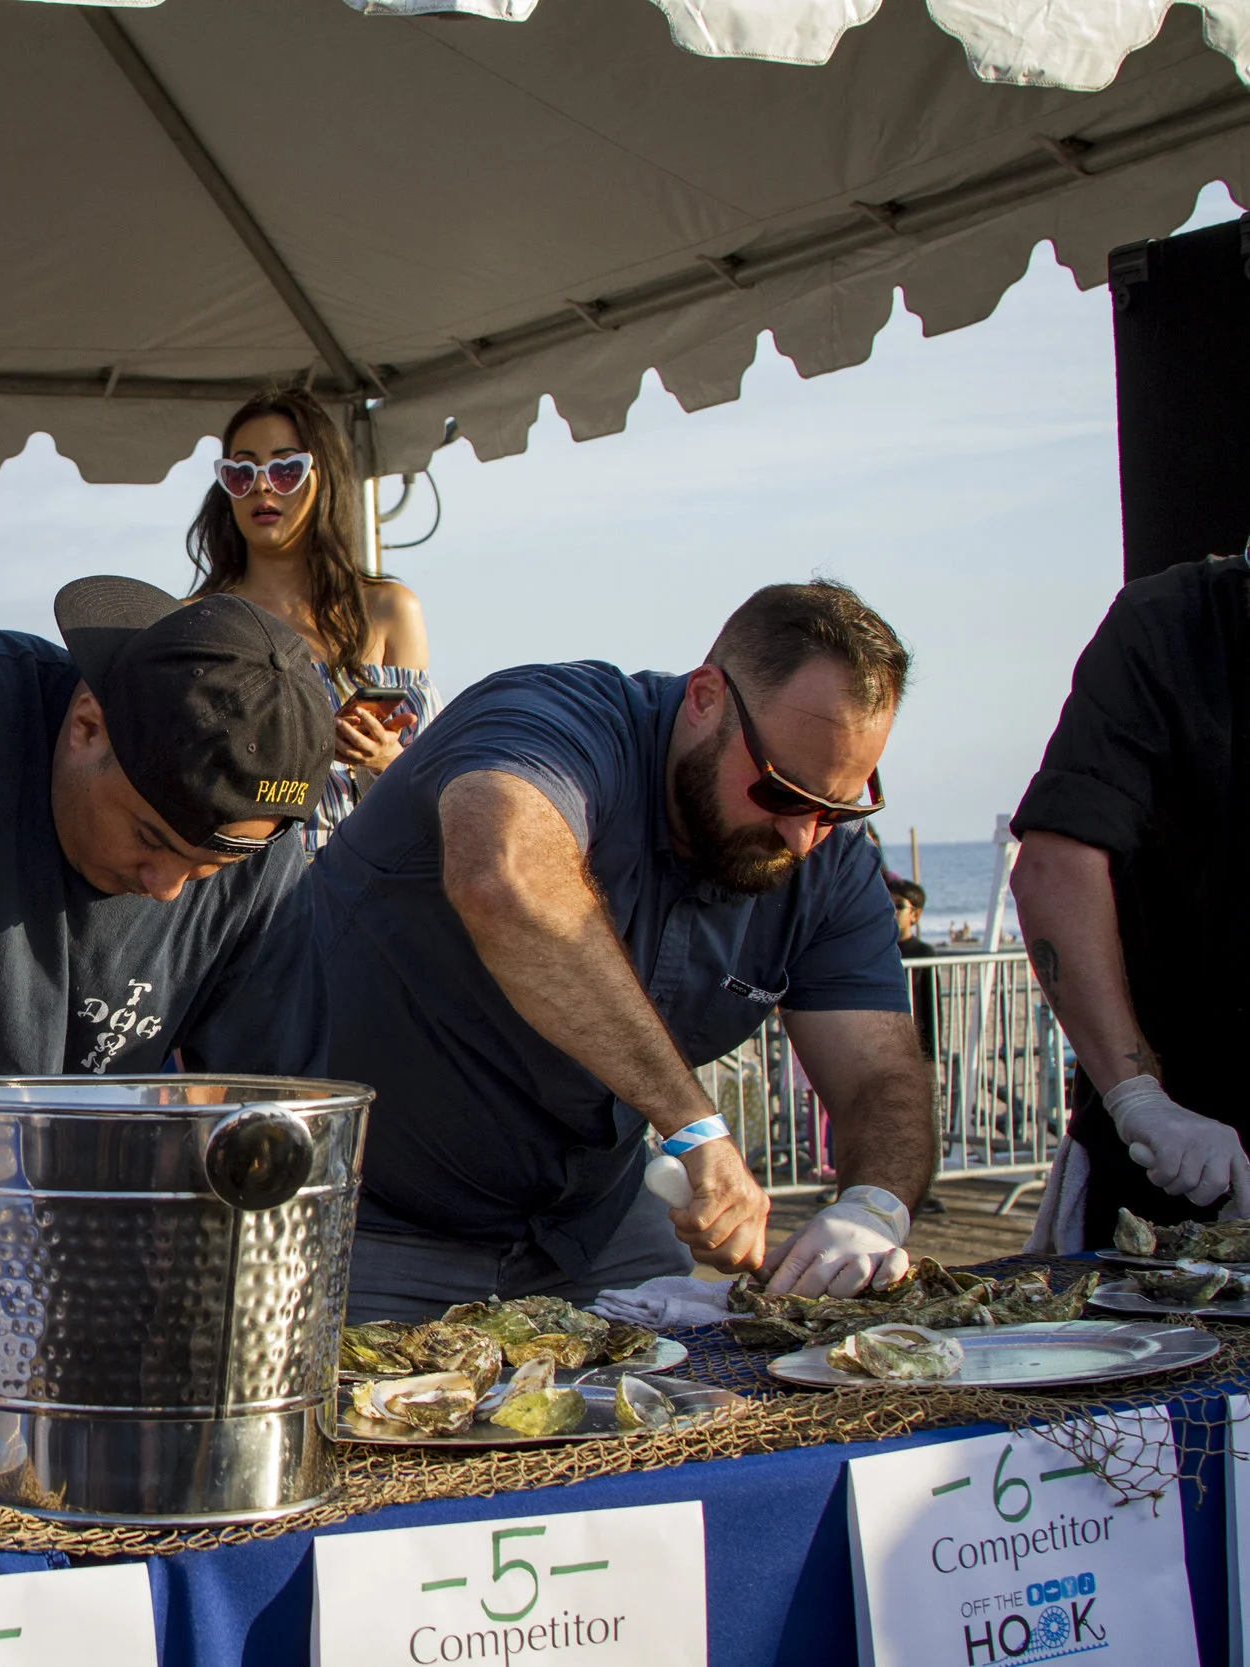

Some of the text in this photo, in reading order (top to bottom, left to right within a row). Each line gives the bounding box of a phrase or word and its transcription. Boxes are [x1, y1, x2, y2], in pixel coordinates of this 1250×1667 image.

[931, 1513, 1114, 1573] Competitor
[961, 1591, 1024, 1618] OFF THE
[409, 1610, 626, 1667] Competitor
